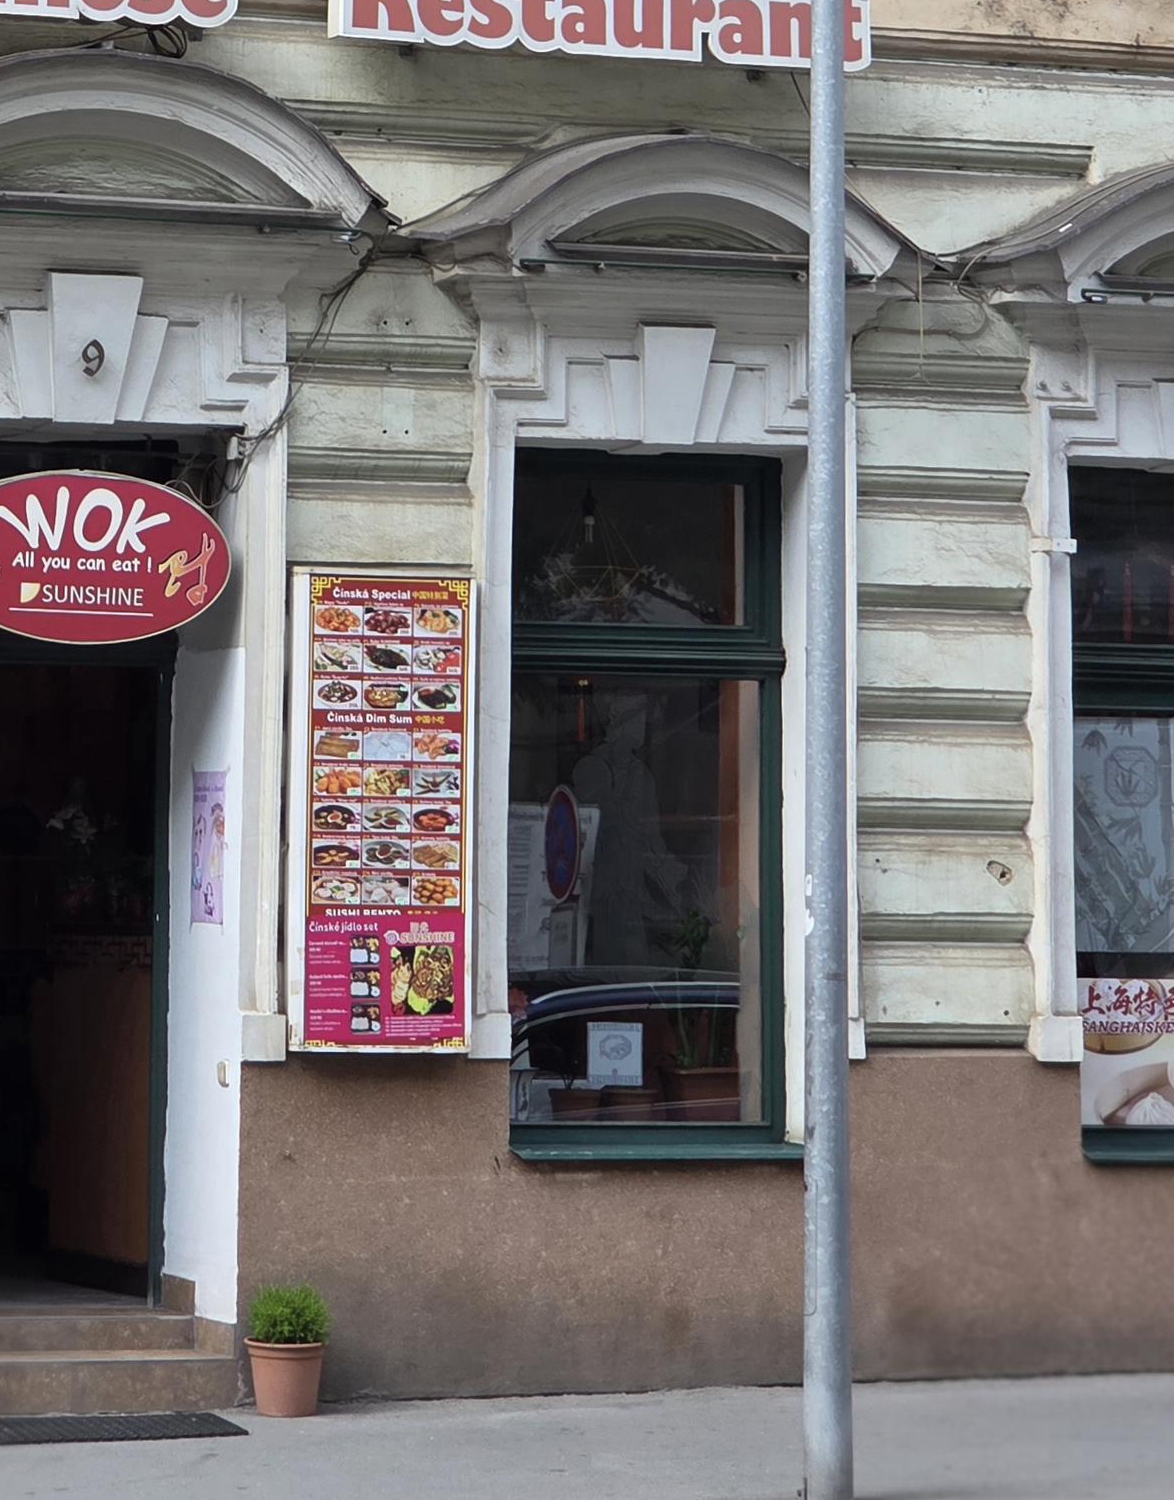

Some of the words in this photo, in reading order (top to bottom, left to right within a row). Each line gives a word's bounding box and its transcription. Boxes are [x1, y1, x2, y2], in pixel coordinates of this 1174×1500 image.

[82, 339, 105, 377] 9
[12, 551, 34, 568] All
[41, 555, 70, 573] you
[77, 557, 105, 572] can
[112, 556, 141, 572] eat
[42, 584, 144, 606] SUNSHINE
[371, 589, 411, 601] Special
[327, 711, 364, 723] Čínská
[366, 713, 386, 723] Dim
[389, 714, 412, 724] Sum
[309, 921, 340, 932] Čínské
[364, 922, 379, 932] set
